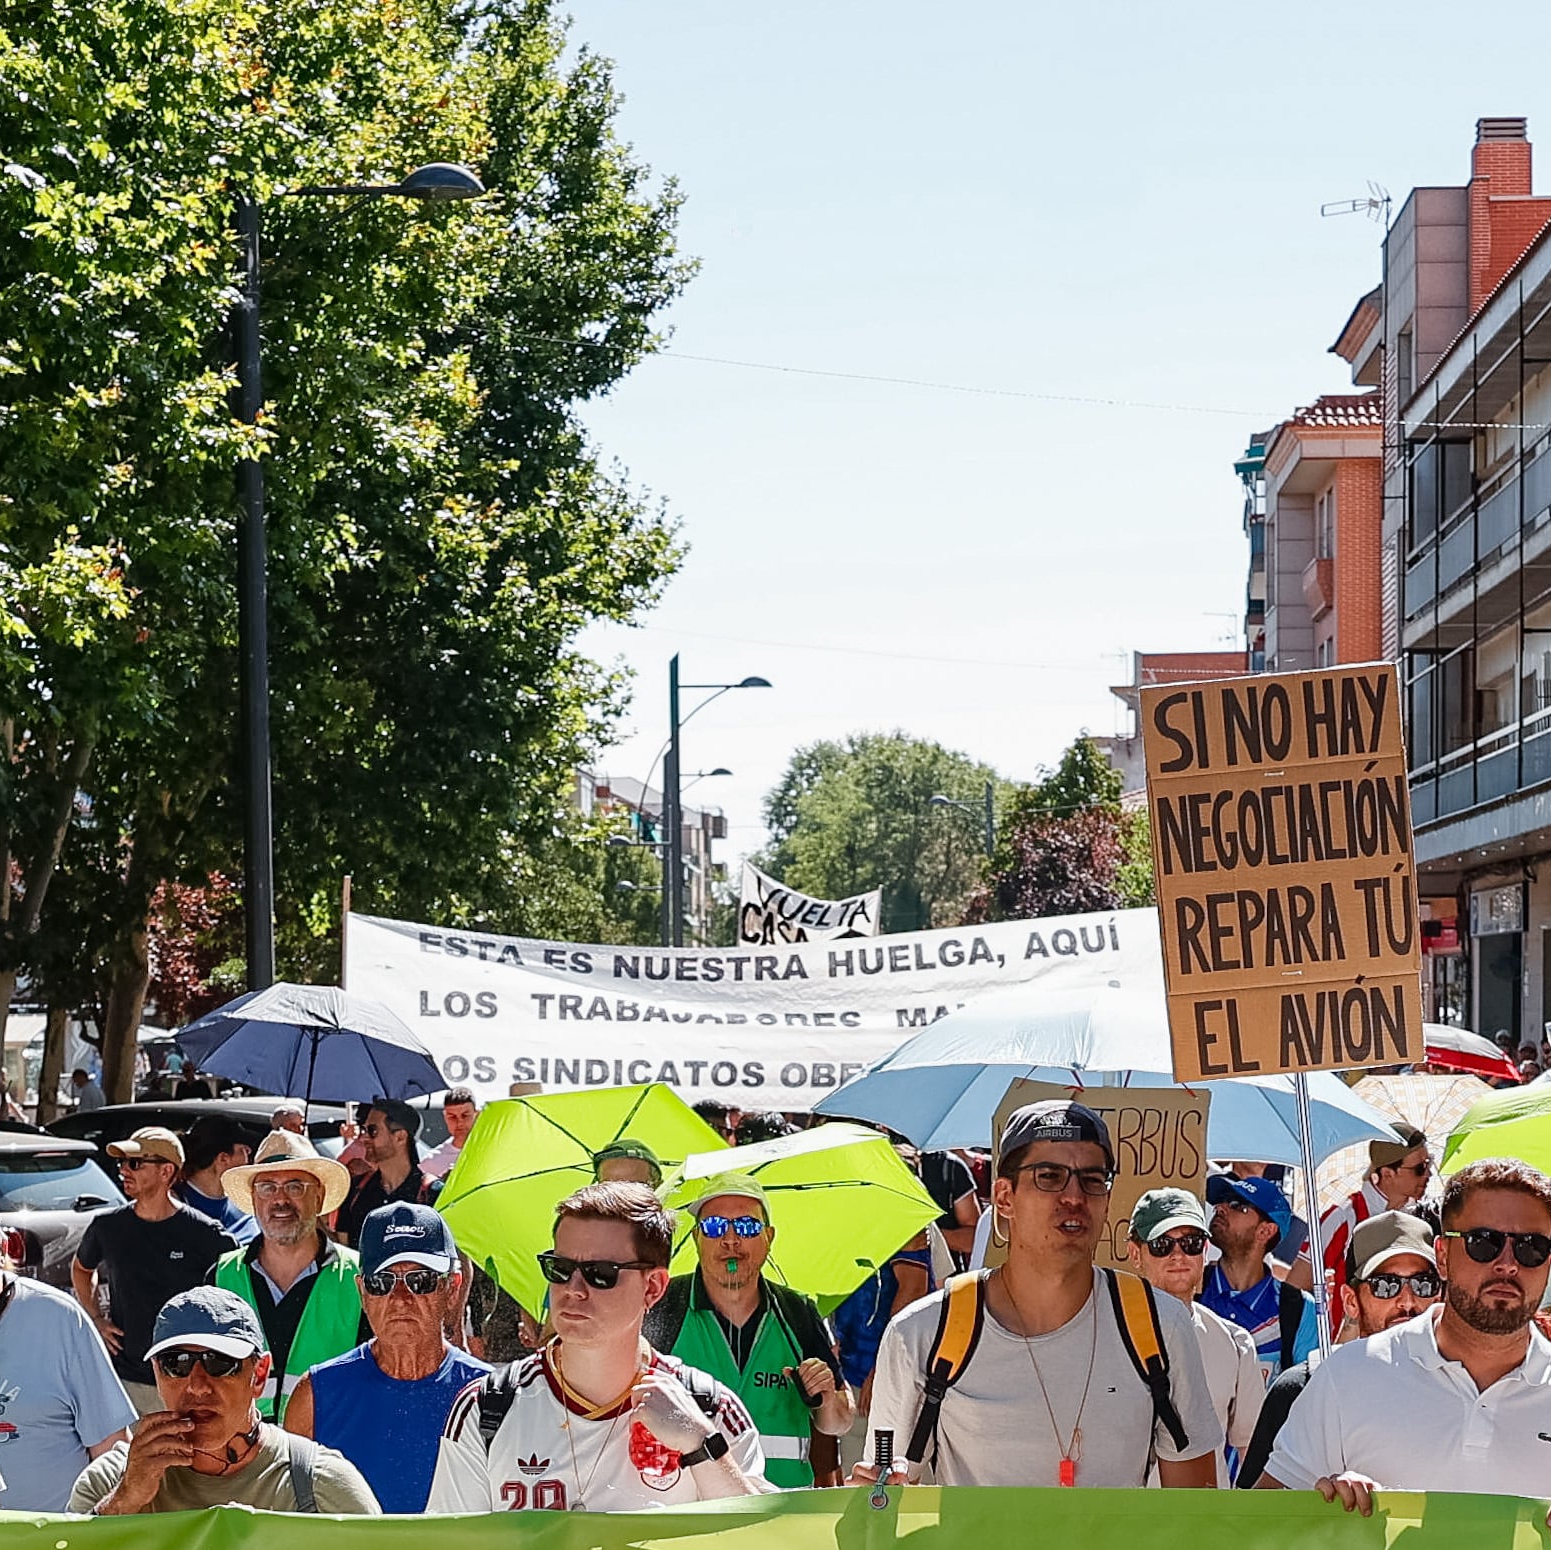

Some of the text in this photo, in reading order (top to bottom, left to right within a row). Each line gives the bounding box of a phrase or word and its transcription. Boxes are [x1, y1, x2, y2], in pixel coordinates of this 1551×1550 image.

[1154, 674, 1389, 773] SI NO HAY
[1157, 760, 1409, 876] NEGOCIACIÓN
[756, 875, 871, 927] VUELTA
[1175, 882, 1345, 975] REPARA
[1354, 862, 1413, 958] TÚ
[419, 917, 1121, 982] ESTA ES NUESTRA HUELGA, AQUÍ
[419, 990, 498, 1019] LOS
[1194, 974, 1409, 1076] EL AVIÓN
[442, 1055, 498, 1083] OS
[513, 1057, 766, 1087] SINDICATOS
[754, 1371, 789, 1391] SIPA
